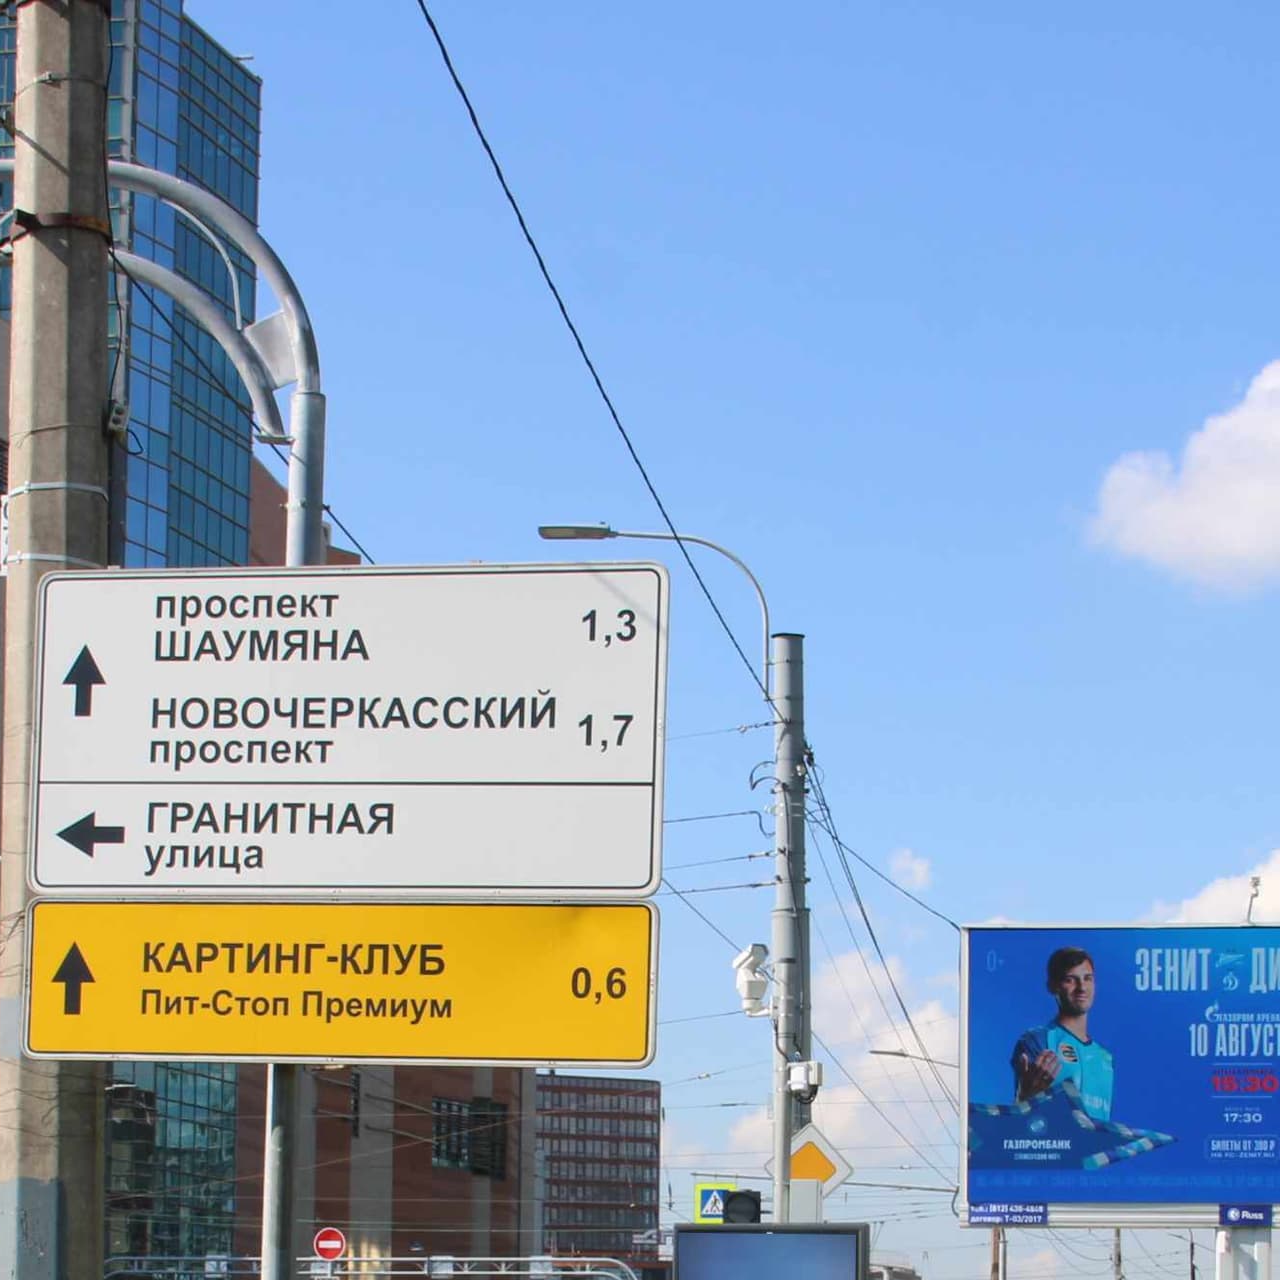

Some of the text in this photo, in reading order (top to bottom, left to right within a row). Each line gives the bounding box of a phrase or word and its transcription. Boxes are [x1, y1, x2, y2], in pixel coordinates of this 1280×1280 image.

[155, 593, 340, 628] проспект
[581, 608, 638, 648] 1,3
[154, 629, 370, 662] ШАУМЯНА
[151, 689, 557, 730] НОВОЧЕРКАССКИЙ
[577, 713, 634, 752] 1,7
[150, 738, 334, 772] проспект
[146, 801, 395, 835] ГРАНИТНАЯ
[144, 843, 264, 877] улица
[142, 941, 446, 977] КАРТИНГ-КЛУБ
[1134, 948, 1212, 992] ЗЕНИТ
[570, 966, 628, 1006] 0,6
[141, 989, 453, 1024] Пит-Стоп Премиум
[1188, 1023, 1209, 1057] 10
[1223, 1112, 1263, 1123] 17:30
[1003, 1139, 1072, 1150] ГАЗПРОМБАНК
[1241, 1210, 1264, 1220] Russ
